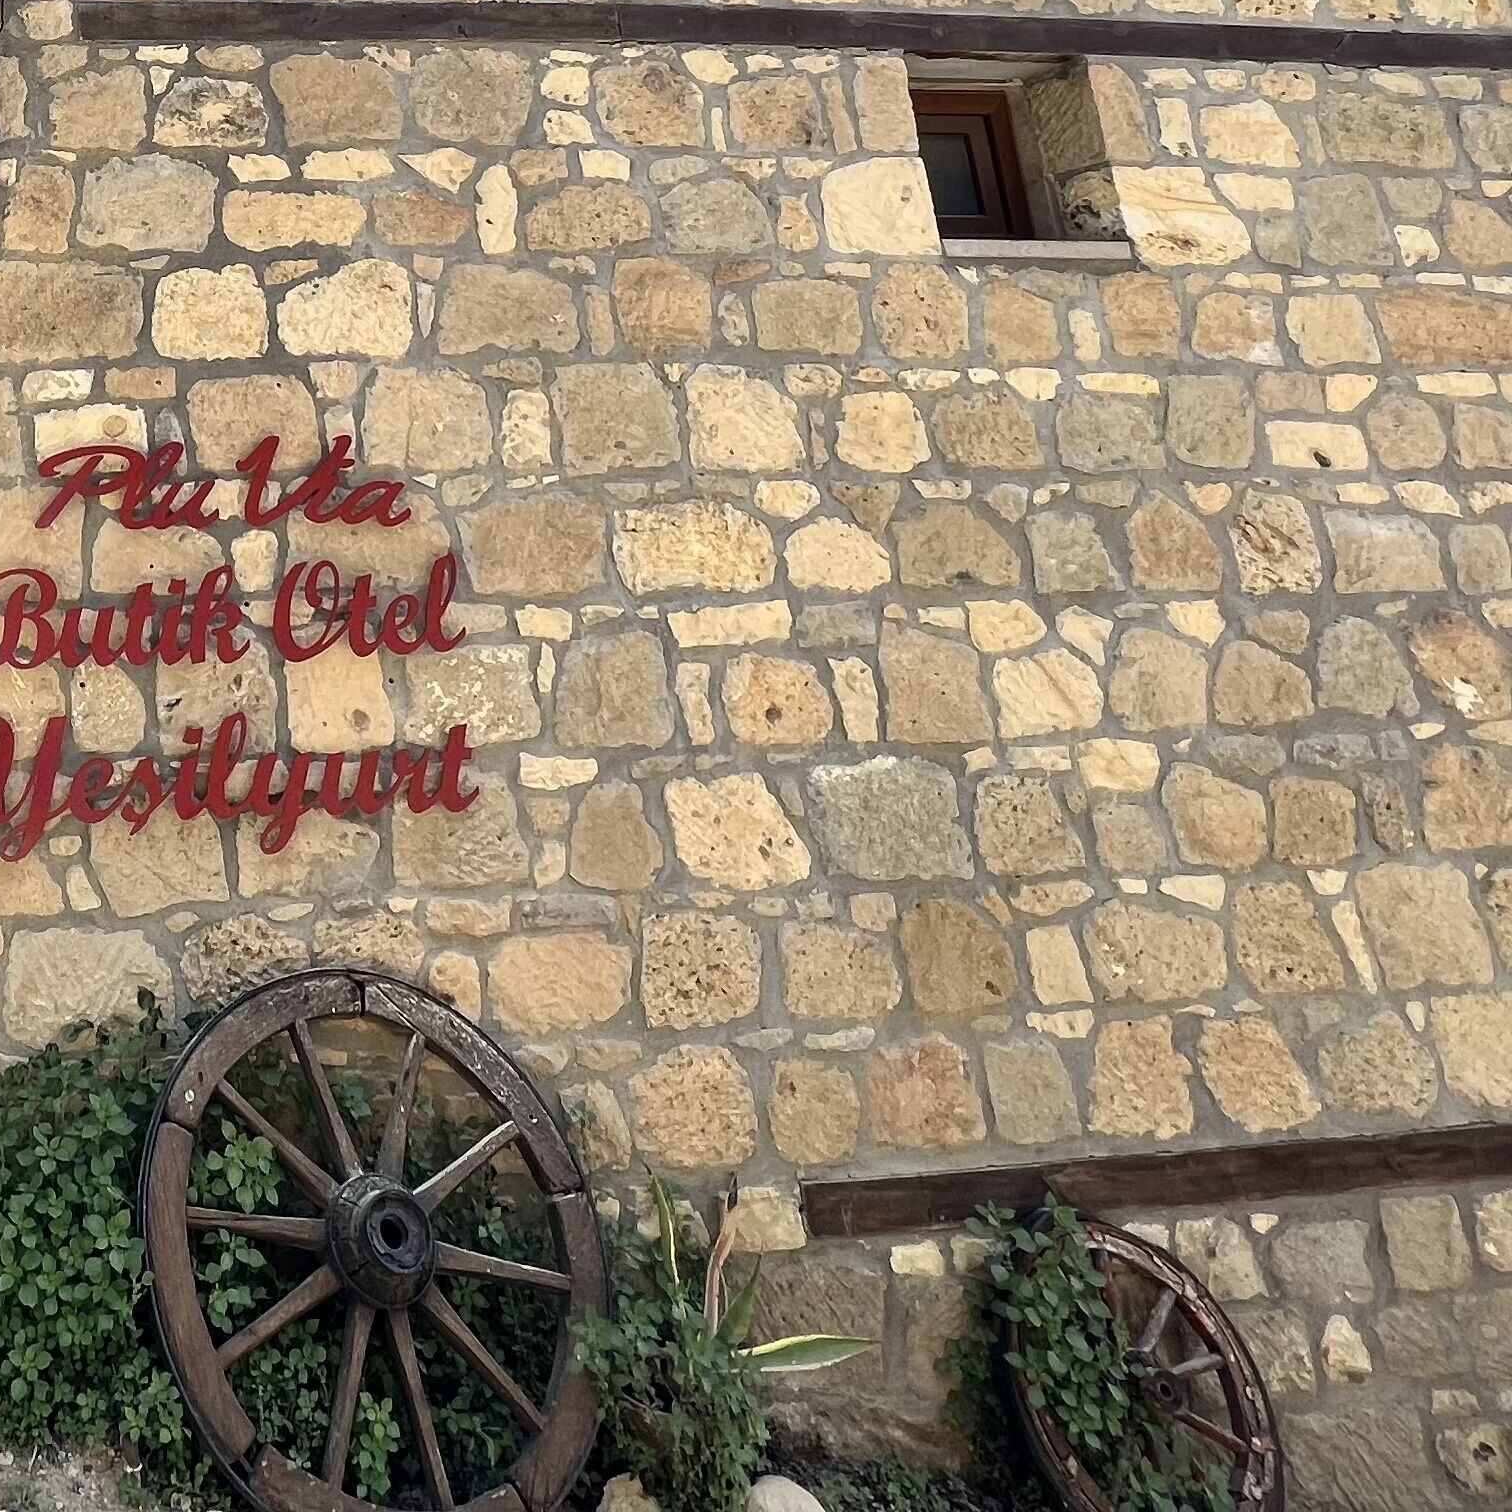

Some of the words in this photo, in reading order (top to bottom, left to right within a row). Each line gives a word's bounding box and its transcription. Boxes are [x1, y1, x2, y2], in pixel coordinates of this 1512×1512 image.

[35, 440, 220, 530] Plu
[236, 434, 412, 528] Via
[272, 553, 466, 663] Otel
